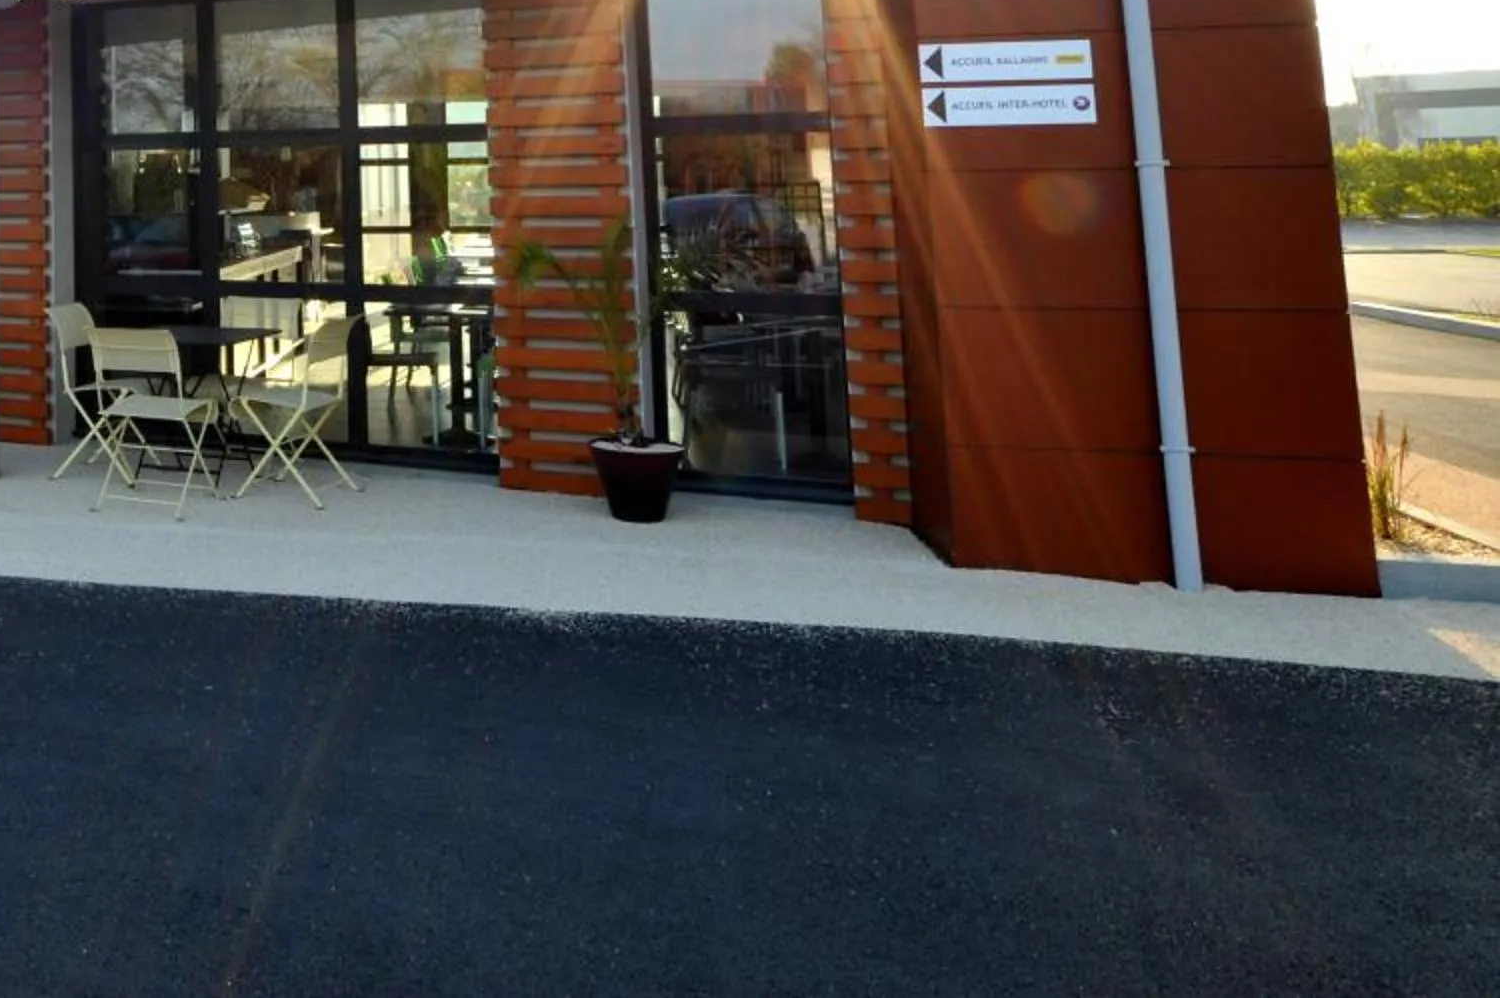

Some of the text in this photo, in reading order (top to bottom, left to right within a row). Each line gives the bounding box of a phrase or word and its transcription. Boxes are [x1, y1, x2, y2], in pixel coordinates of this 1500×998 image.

[951, 55, 993, 66] ACCUEIL
[951, 98, 1068, 112] ACCUEIL INTER-HOTEL
